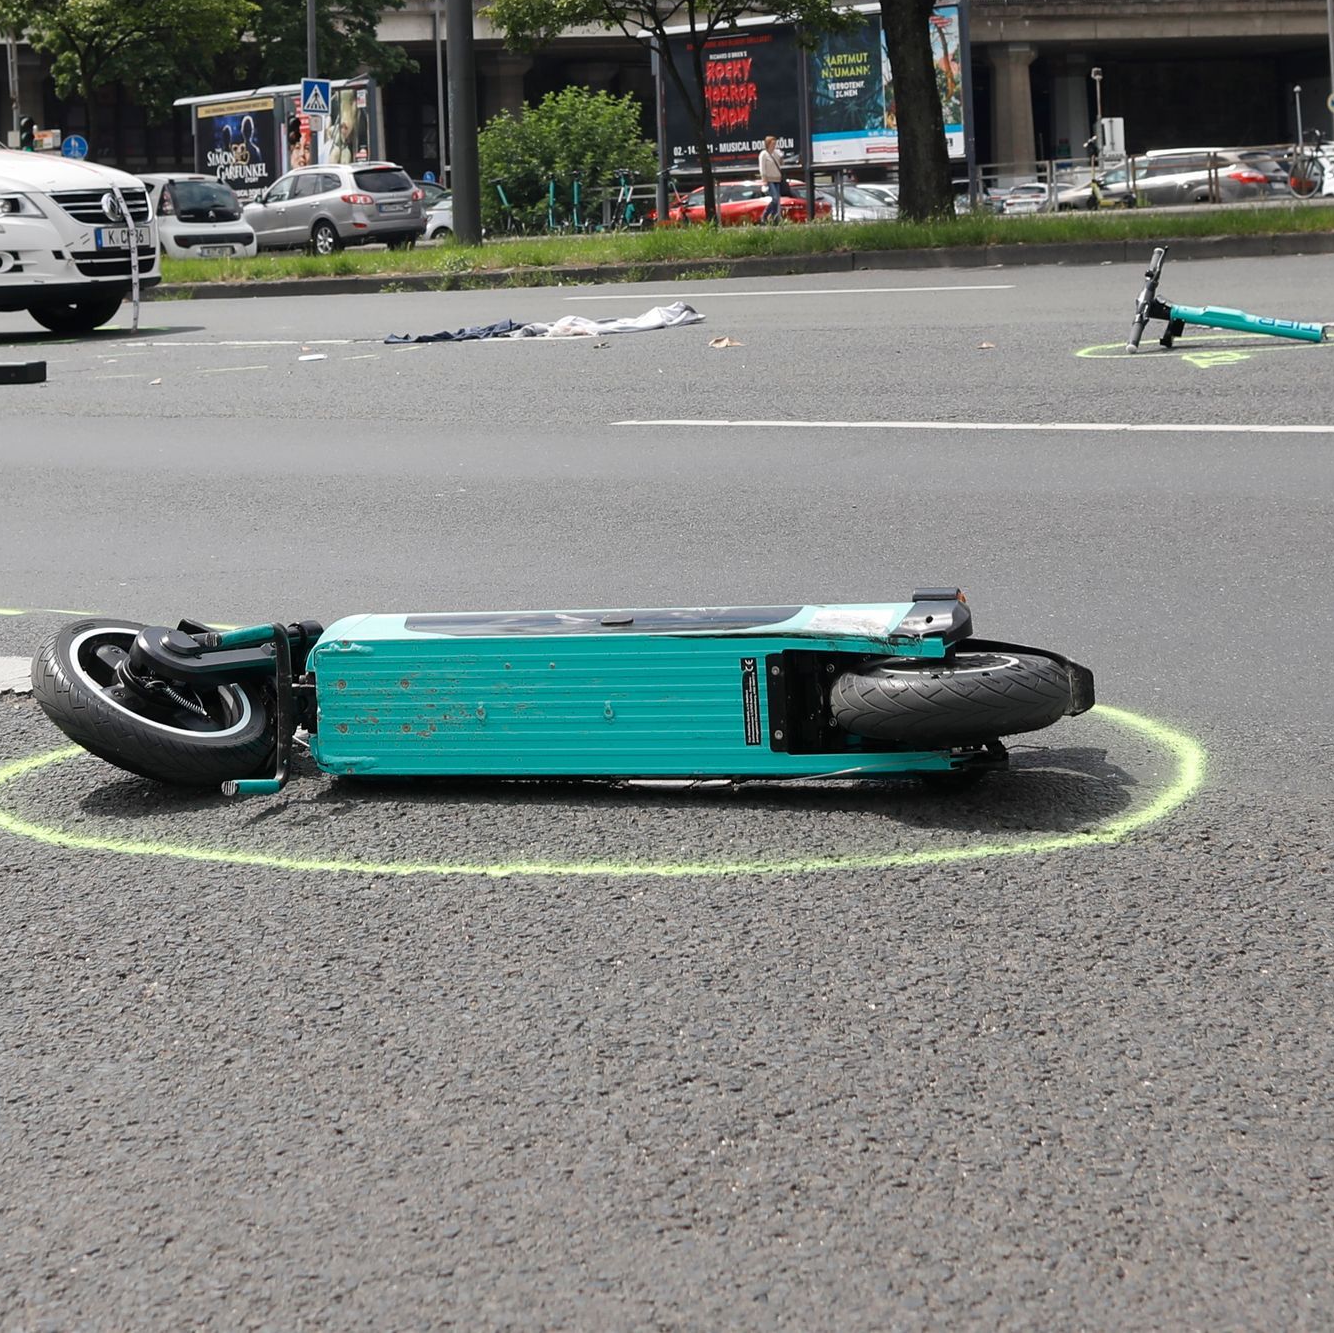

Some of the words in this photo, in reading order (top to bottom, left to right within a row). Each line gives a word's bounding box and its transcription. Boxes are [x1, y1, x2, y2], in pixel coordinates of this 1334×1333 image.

[823, 52, 868, 66] HARTMUT
[706, 58, 752, 81] ROCKY
[821, 65, 871, 79] NEUMANN
[705, 82, 757, 104] HORROR
[711, 105, 751, 130] SHOW
[719, 141, 751, 153] MUSICAL
[207, 151, 235, 166] SIMON
[217, 163, 269, 183] GARFUNKEL
[108, 230, 115, 245] K
